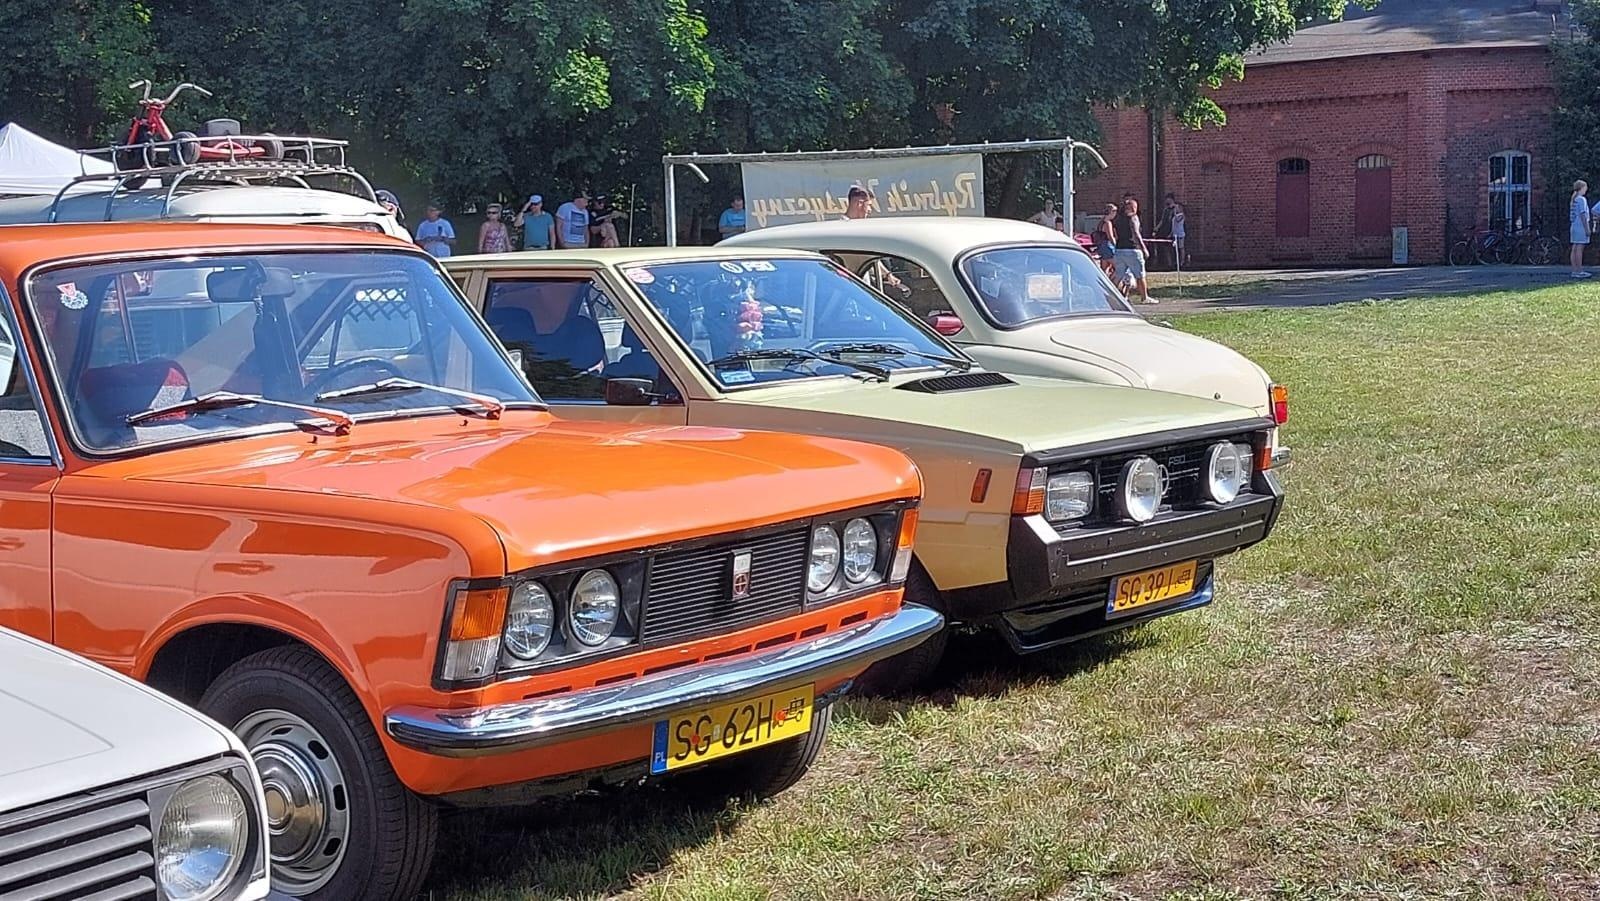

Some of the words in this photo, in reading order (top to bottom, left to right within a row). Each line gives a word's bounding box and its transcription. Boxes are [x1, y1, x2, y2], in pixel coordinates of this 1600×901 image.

[1119, 576, 1141, 606] SG
[675, 715, 712, 761] SG
[723, 699, 774, 749] 62H
[655, 752, 665, 764] PL
